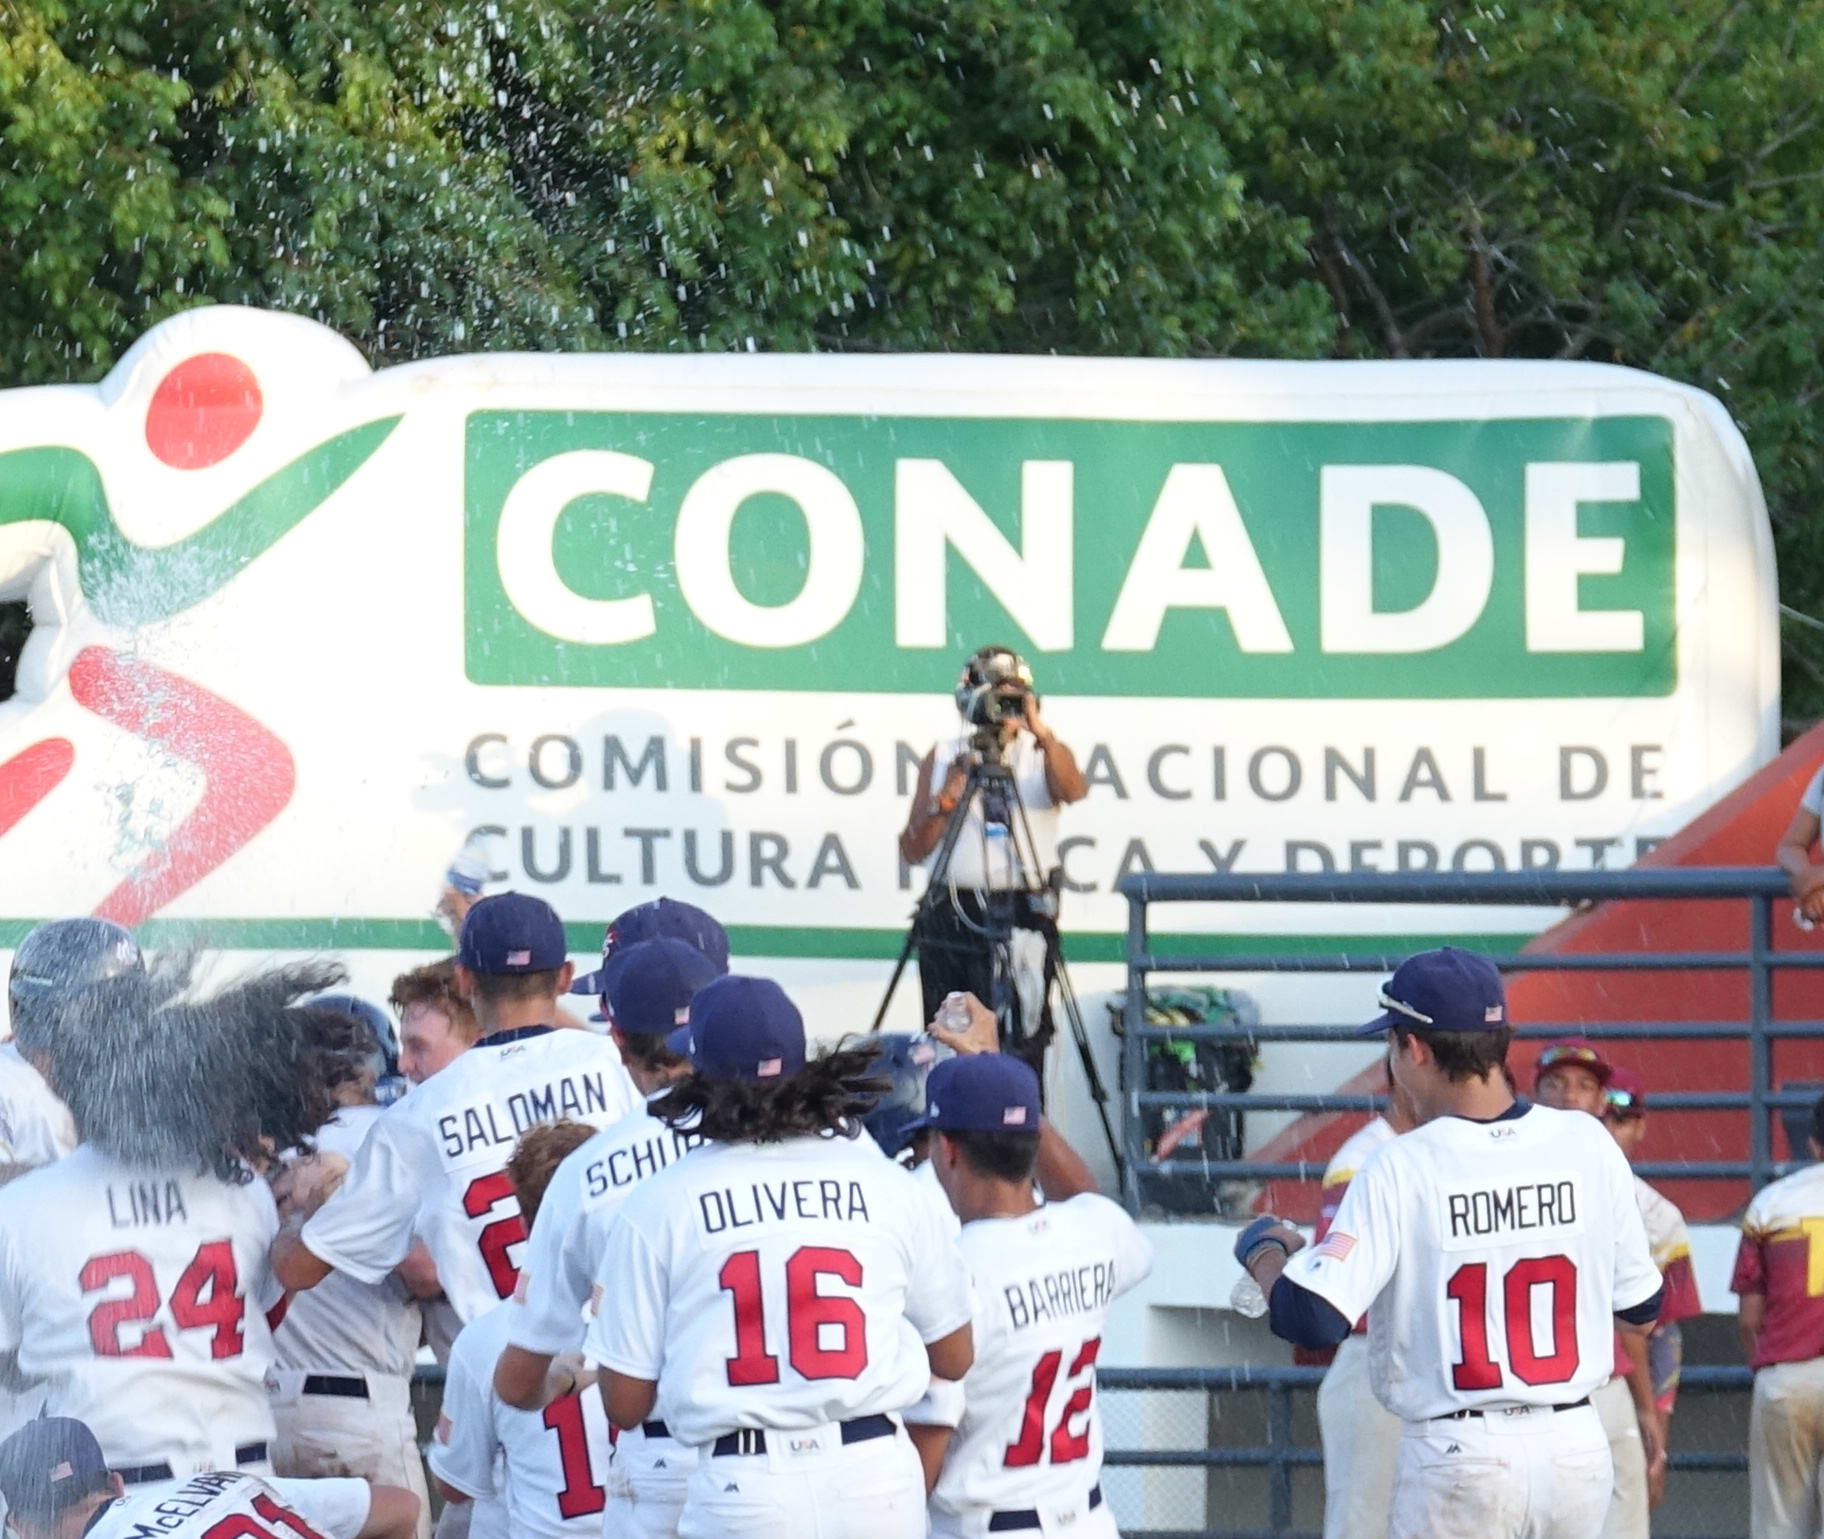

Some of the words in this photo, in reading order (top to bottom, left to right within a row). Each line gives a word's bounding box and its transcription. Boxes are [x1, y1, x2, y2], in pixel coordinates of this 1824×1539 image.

[497, 449, 1645, 652] CONADE
[1084, 742, 1509, 802] ACIONAL
[1559, 744, 1664, 801] DE
[464, 824, 862, 891] CULTURA
[438, 1072, 608, 1158] SALOMAN
[107, 1178, 188, 1228] LINA
[699, 1180, 870, 1234] OLIVERA
[1448, 1180, 1576, 1238] ROMERO
[78, 1238, 246, 1361] 24
[718, 1245, 868, 1387] 16
[1004, 1259, 1115, 1331] BARRIERA
[1447, 1254, 1579, 1391] 10
[1003, 1333, 1101, 1469] 12
